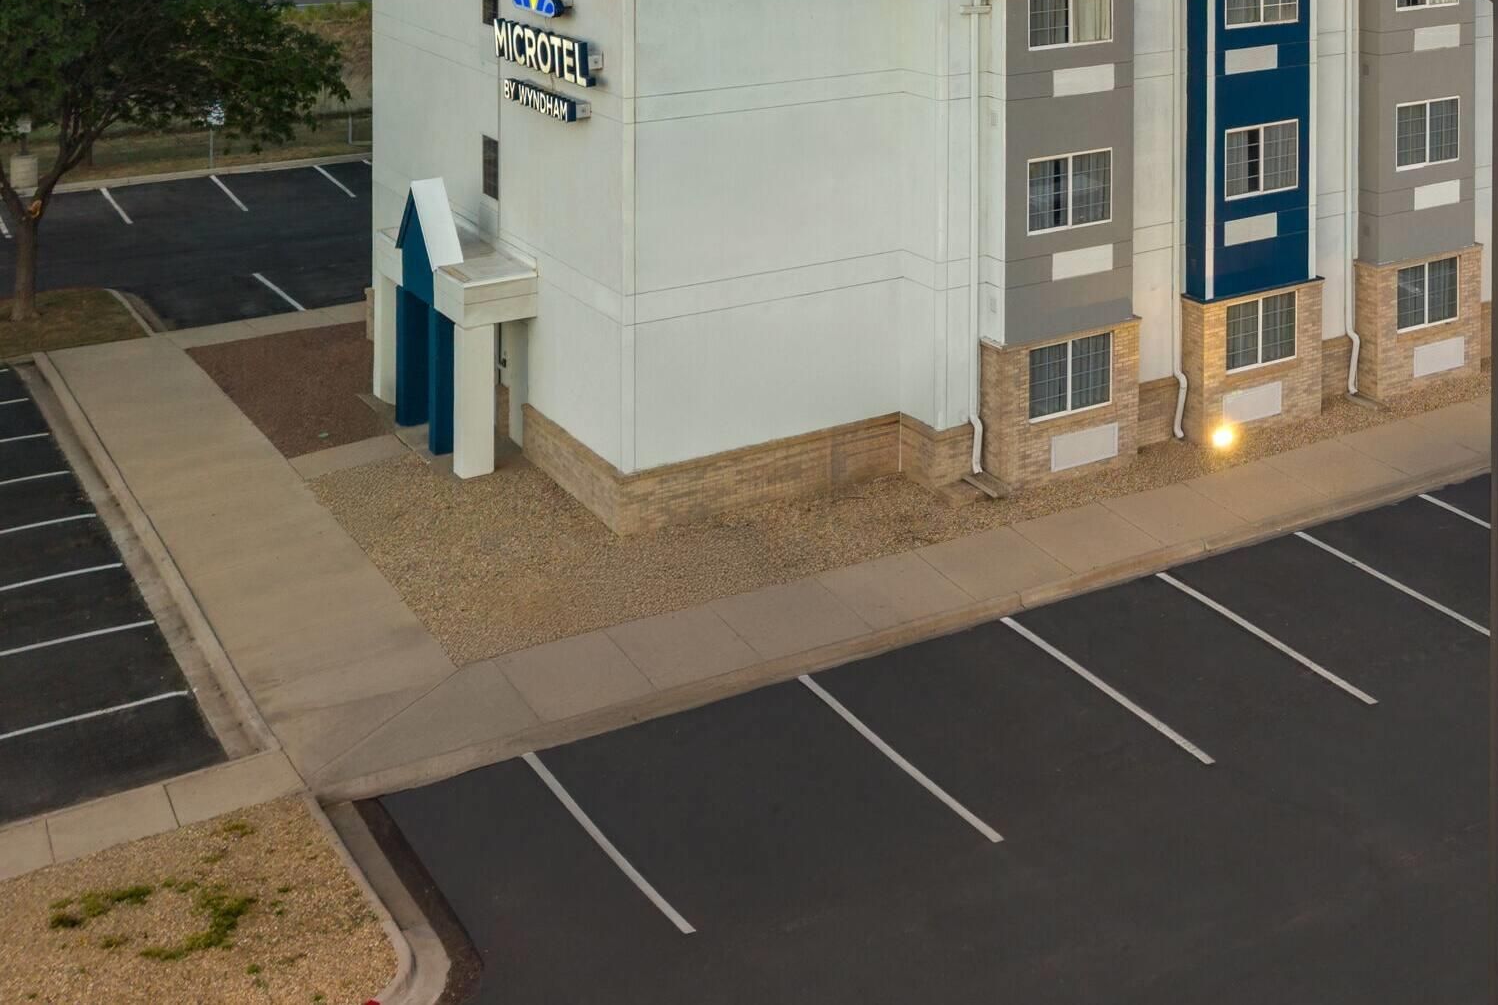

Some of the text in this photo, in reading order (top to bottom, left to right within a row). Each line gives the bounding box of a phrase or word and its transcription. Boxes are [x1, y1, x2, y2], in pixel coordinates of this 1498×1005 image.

[494, 18, 588, 87] MICROTEL
[504, 79, 568, 122] BY WYNDHAM
